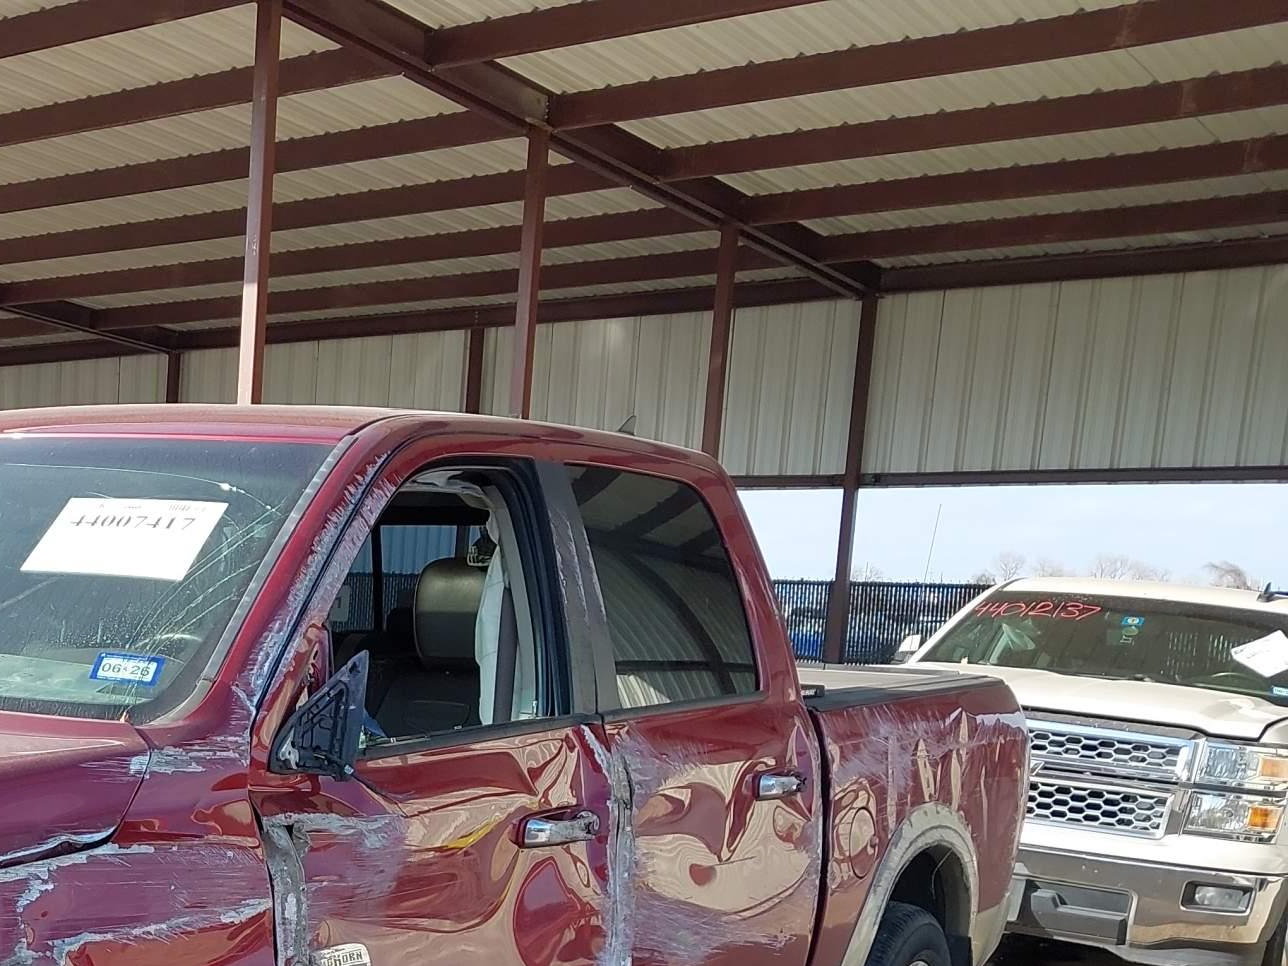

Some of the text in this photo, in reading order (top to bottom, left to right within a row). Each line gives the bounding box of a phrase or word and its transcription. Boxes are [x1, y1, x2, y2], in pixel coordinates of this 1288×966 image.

[71, 514, 196, 530] 44007417
[101, 662, 151, 677] 06 26
